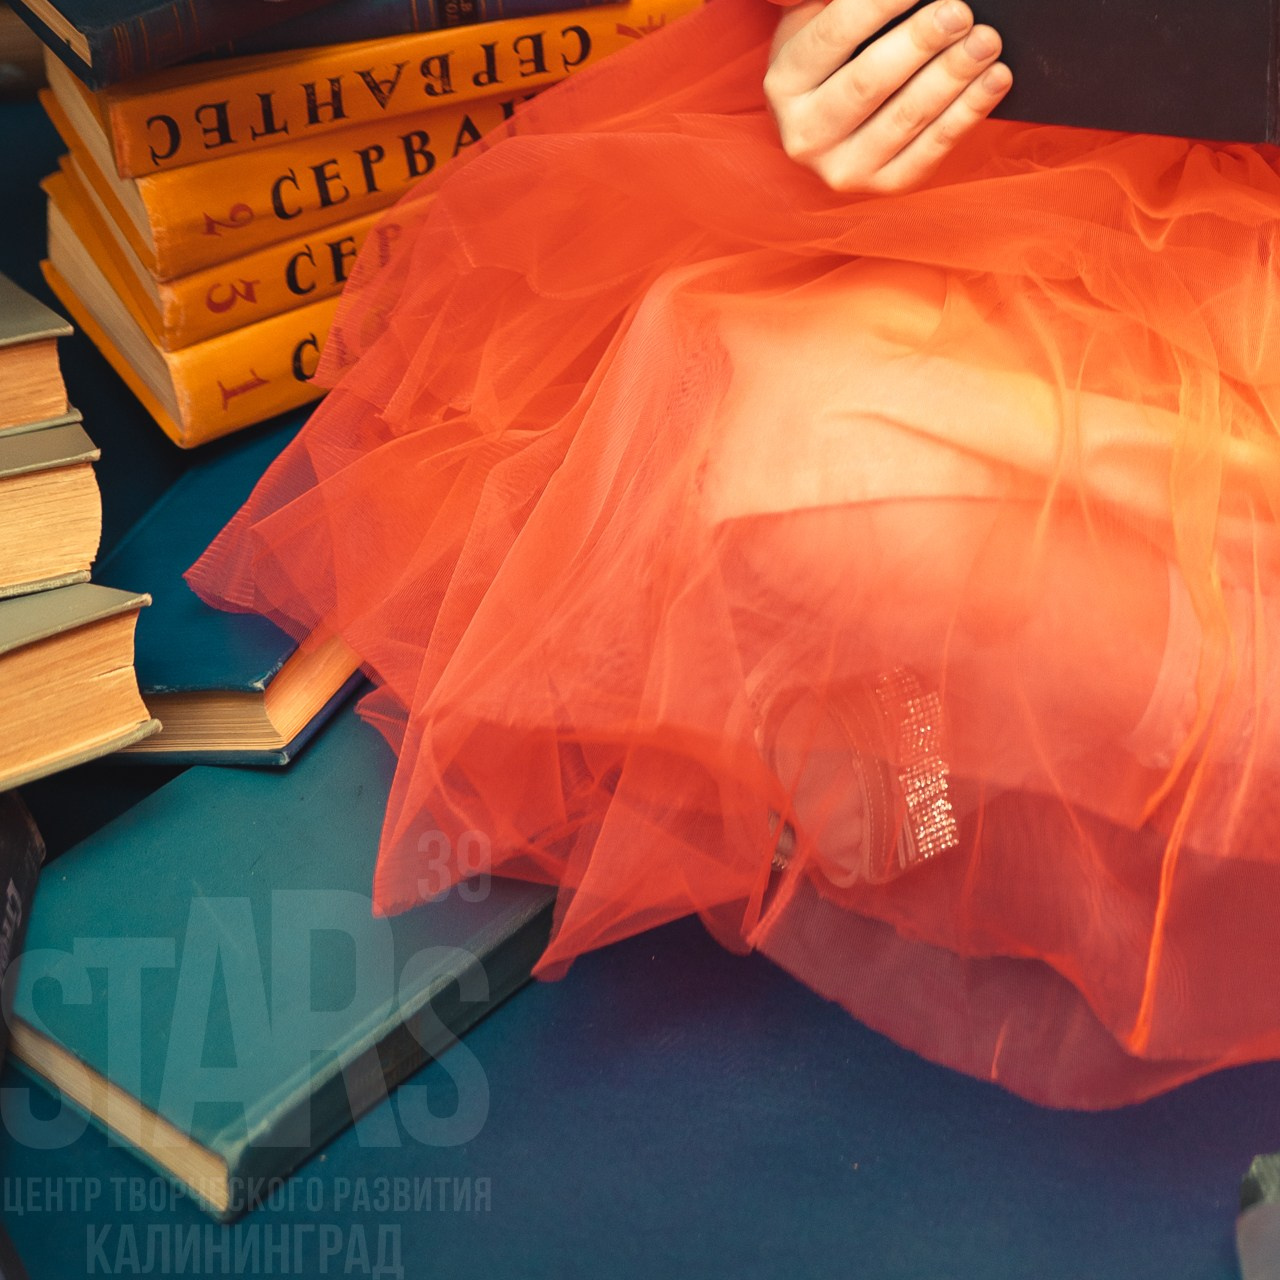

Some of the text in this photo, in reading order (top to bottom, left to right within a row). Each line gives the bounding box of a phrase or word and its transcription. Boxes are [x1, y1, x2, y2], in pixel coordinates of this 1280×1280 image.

[146, 25, 592, 166] СЕРВАНТЕС
[202, 201, 255, 237] 2
[205, 277, 261, 315] 3
[217, 368, 270, 412] 1
